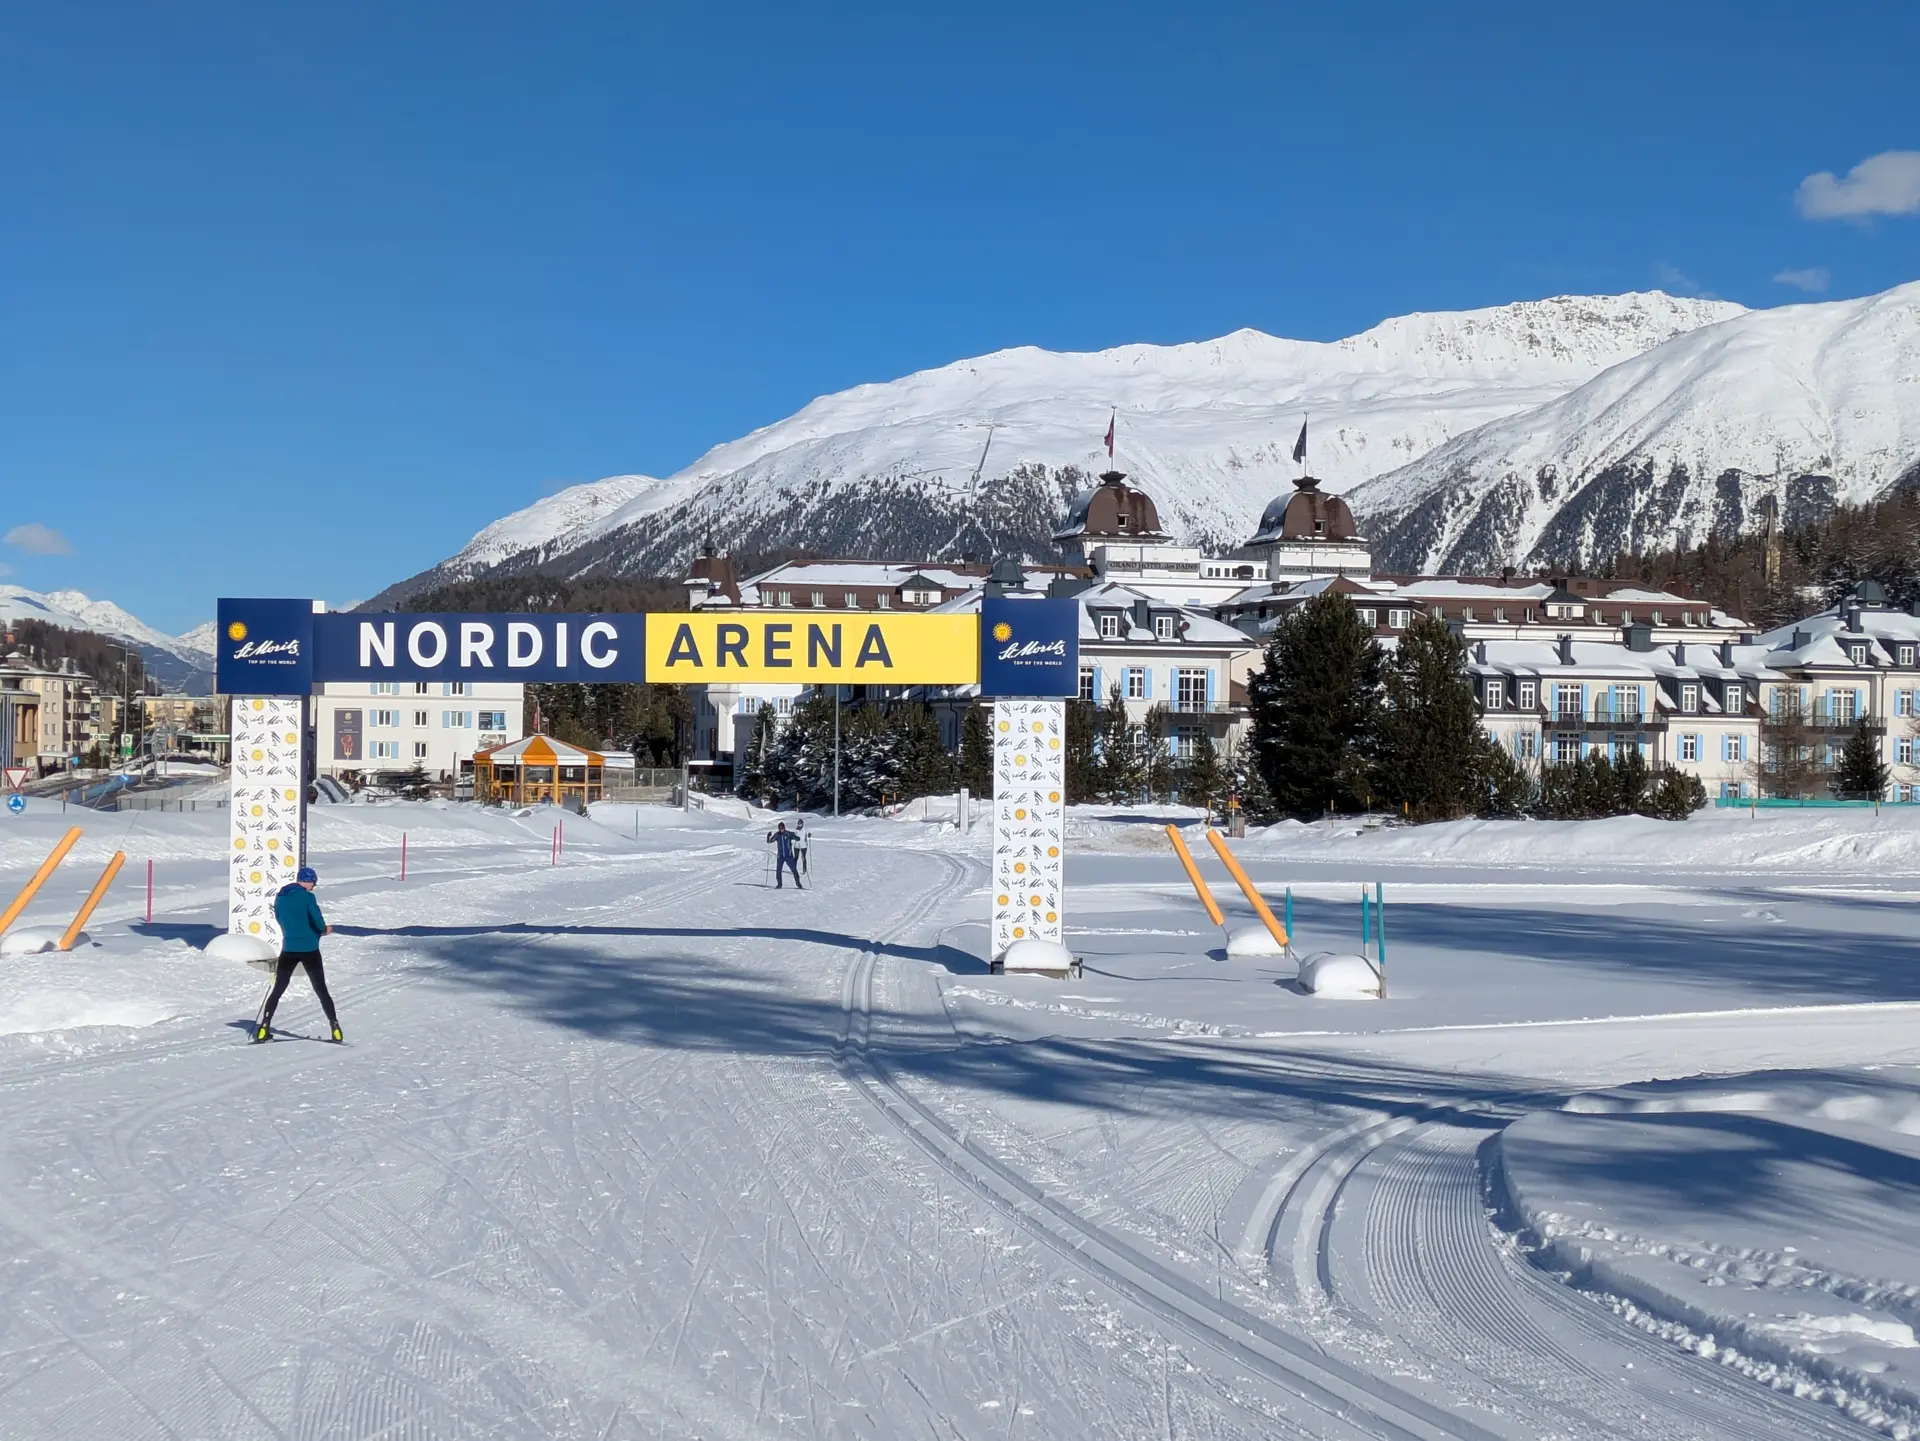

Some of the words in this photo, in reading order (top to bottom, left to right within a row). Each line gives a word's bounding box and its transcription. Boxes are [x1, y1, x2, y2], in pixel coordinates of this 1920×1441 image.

[250, 640, 299, 656] Moritz
[360, 622, 618, 667] NORDIC
[665, 624, 894, 668] ARENA
[1015, 640, 1066, 656] Moritz
